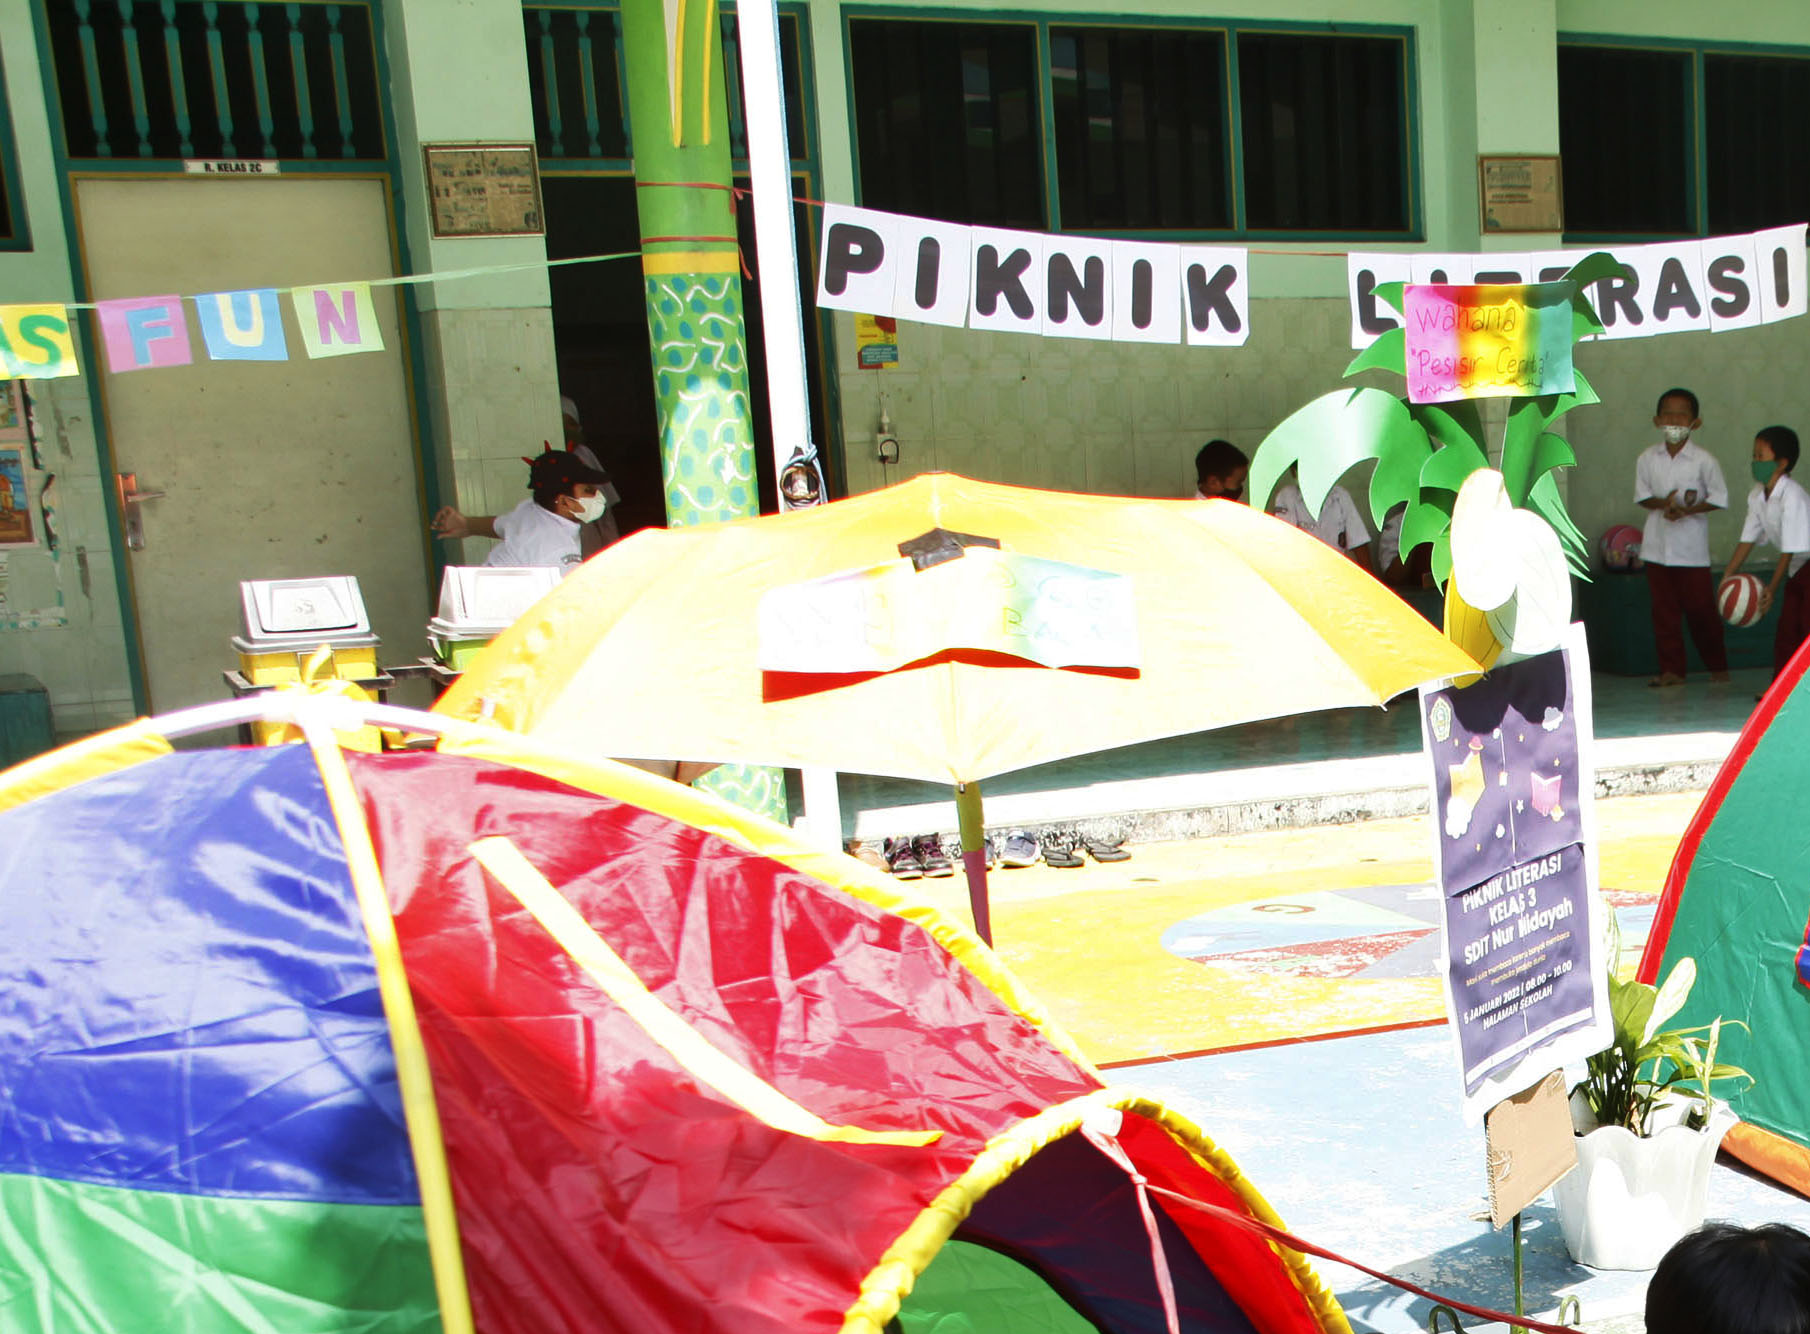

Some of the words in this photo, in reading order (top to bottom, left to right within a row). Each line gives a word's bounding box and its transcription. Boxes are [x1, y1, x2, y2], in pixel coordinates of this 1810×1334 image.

[217, 163, 247, 173] KELAS
[824, 223, 1242, 333] PIKNIK
[1357, 247, 1789, 335] LRASI
[126, 290, 362, 366] FUN
[1415, 297, 1516, 333] Wahana
[1462, 876, 1504, 913] PIKNIK
[1506, 853, 1562, 892] LITERASI
[1489, 892, 1526, 926] KELAS
[1528, 887, 1537, 907] 3
[1464, 934, 1490, 965] SDIT
[1492, 925, 1515, 950] Nur
[1518, 897, 1574, 938] Hidayah
[1469, 995, 1502, 1021] JANUARI
[1502, 986, 1520, 1005] 2022
[1553, 960, 1573, 979] 10.00
[1482, 1002, 1519, 1031] HALAMAN
[1520, 984, 1553, 1010] SEKOLAH
